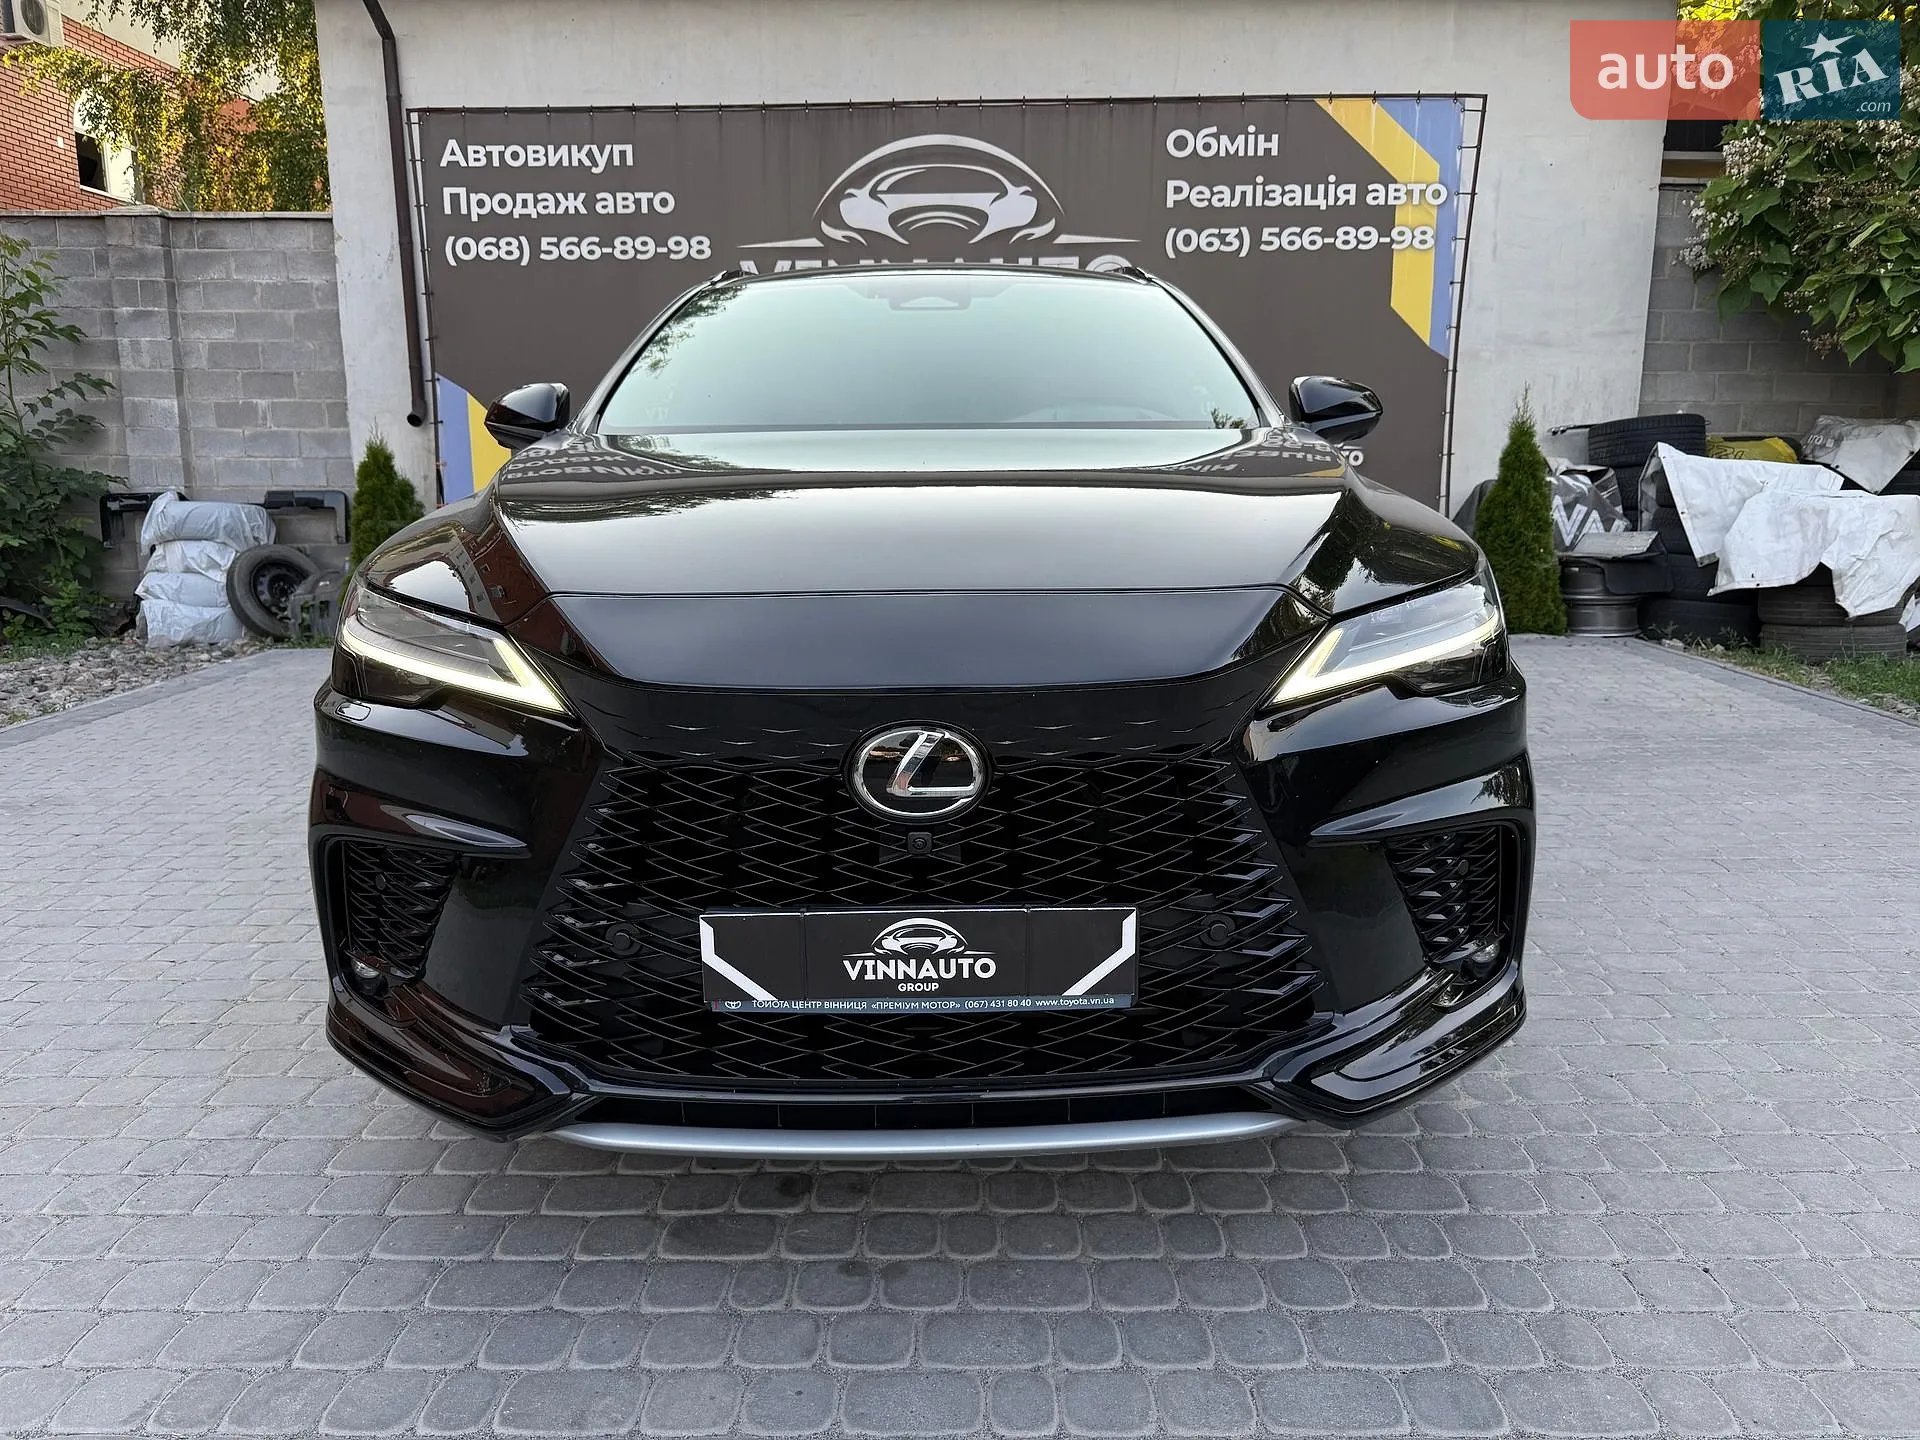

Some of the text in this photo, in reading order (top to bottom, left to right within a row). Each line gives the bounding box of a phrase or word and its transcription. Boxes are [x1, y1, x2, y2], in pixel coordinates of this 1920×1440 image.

[440, 138, 634, 174] Автовикуп
[1165, 125, 1279, 158] Обмін
[442, 187, 676, 222] Продаж авто
[1165, 174, 1448, 210] Реалізація авто
[445, 235, 712, 266] (068) 566-89-98
[1165, 225, 1435, 259] (063) 566-89-98
[842, 957, 997, 981] VINNAUTO
[792, 1001, 822, 1010] ЦЕНТР
[824, 1001, 867, 1010] ВІННИЦЯ
[964, 1000, 988, 1009] (067)
[990, 1000, 1005, 1008] 431
[1008, 999, 1018, 1007] 80
[1019, 999, 1032, 1007] 40
[1035, 997, 1115, 1008] www.toyota.vn.ua
[897, 982, 940, 992] GROUP
